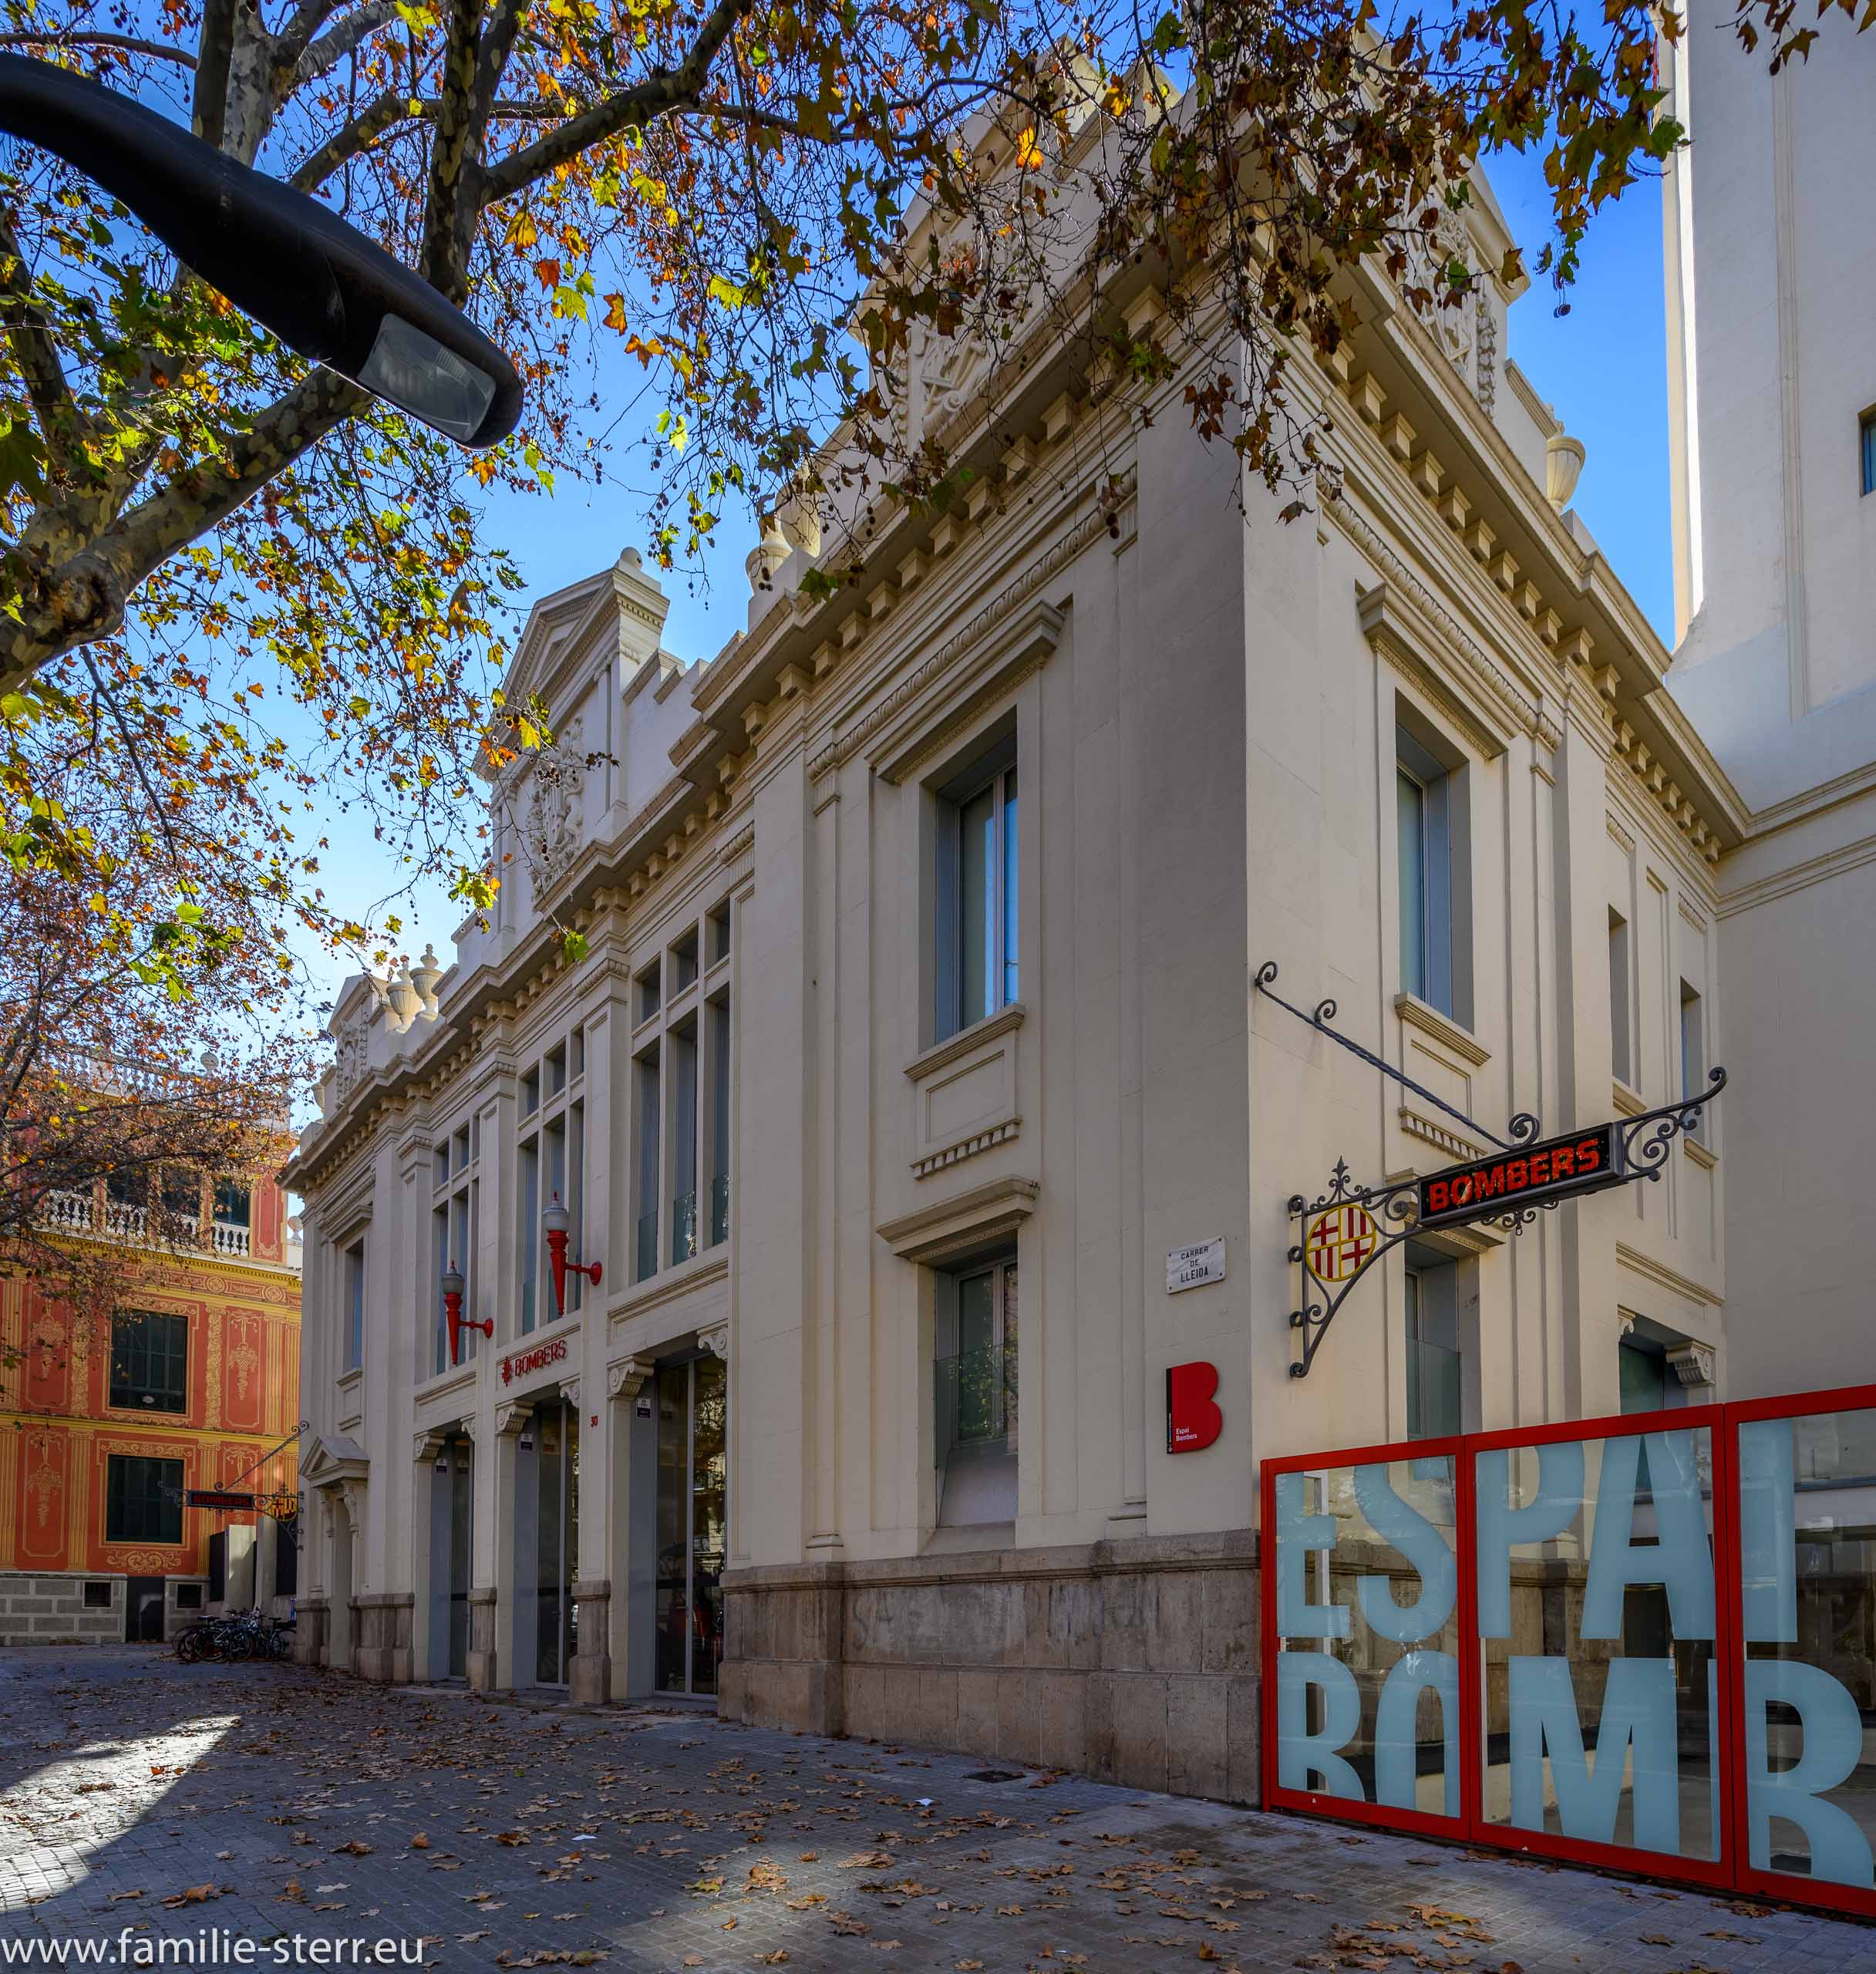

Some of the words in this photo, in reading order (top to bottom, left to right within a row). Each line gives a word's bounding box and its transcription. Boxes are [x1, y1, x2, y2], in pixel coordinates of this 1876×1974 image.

[1429, 1137, 1600, 1211] BOMBERS
[1180, 1246, 1208, 1259] CARRER
[1190, 1258, 1200, 1267] DE
[1180, 1266, 1208, 1282] LLEIDA
[515, 1340, 566, 1376] BOMBERS
[1275, 1421, 1797, 1642] ESPAI
